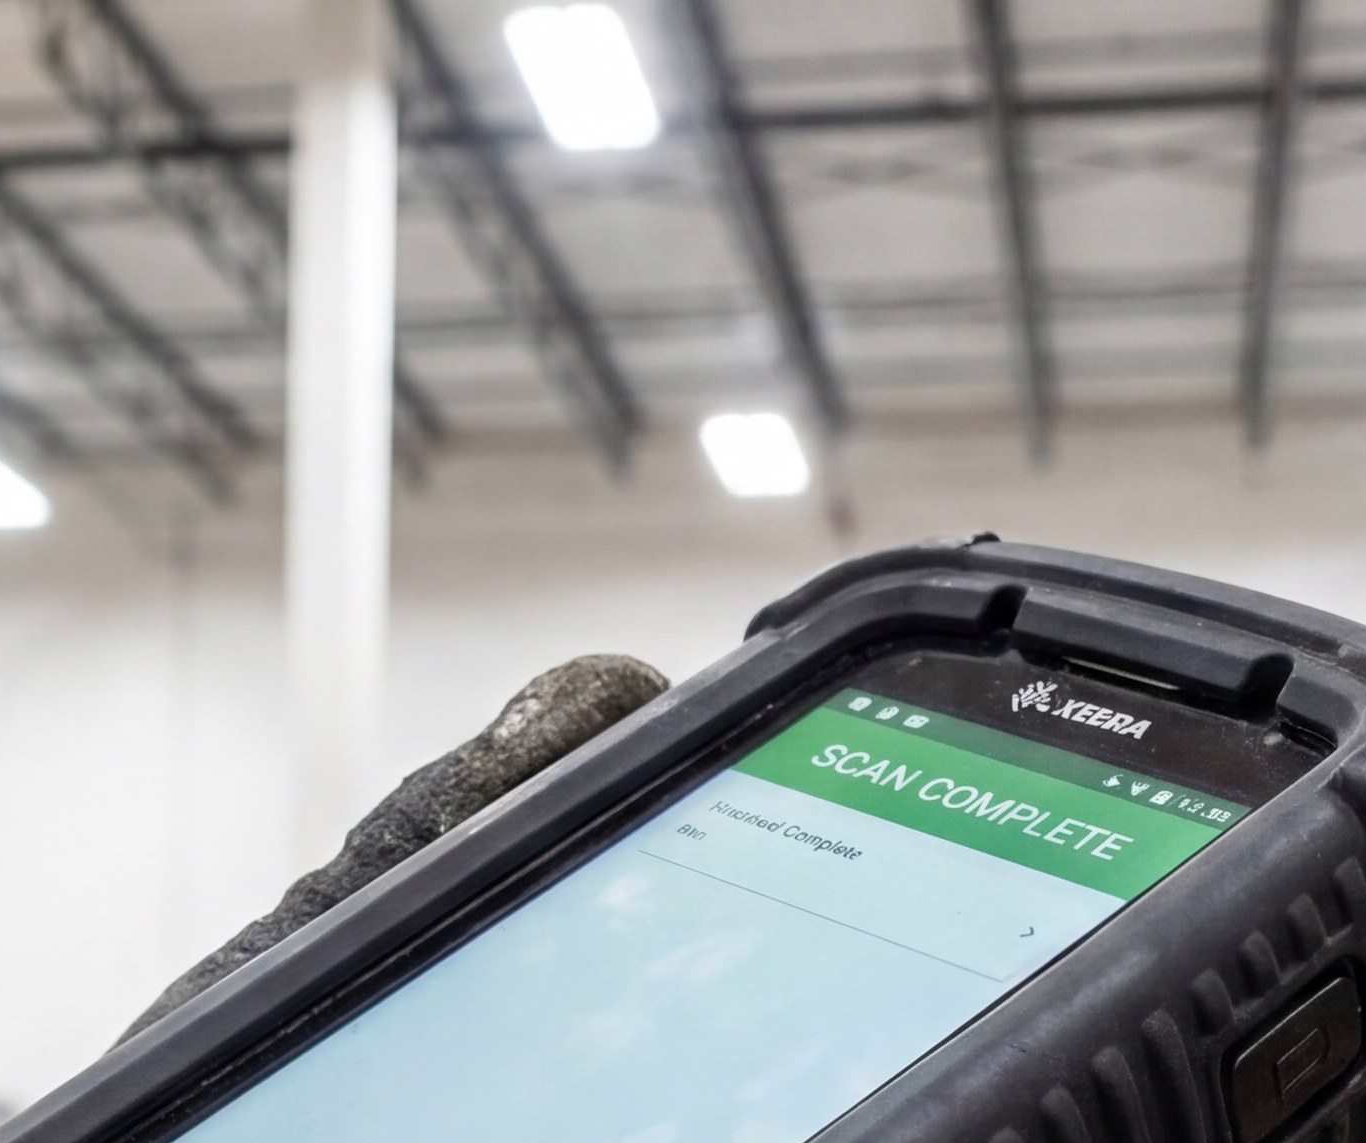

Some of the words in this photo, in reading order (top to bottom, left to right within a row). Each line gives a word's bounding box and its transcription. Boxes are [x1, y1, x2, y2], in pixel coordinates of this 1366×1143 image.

[1051, 699, 1152, 740] XEERA
[811, 744, 923, 792] SCAN
[918, 777, 1134, 861] COMPLETE
